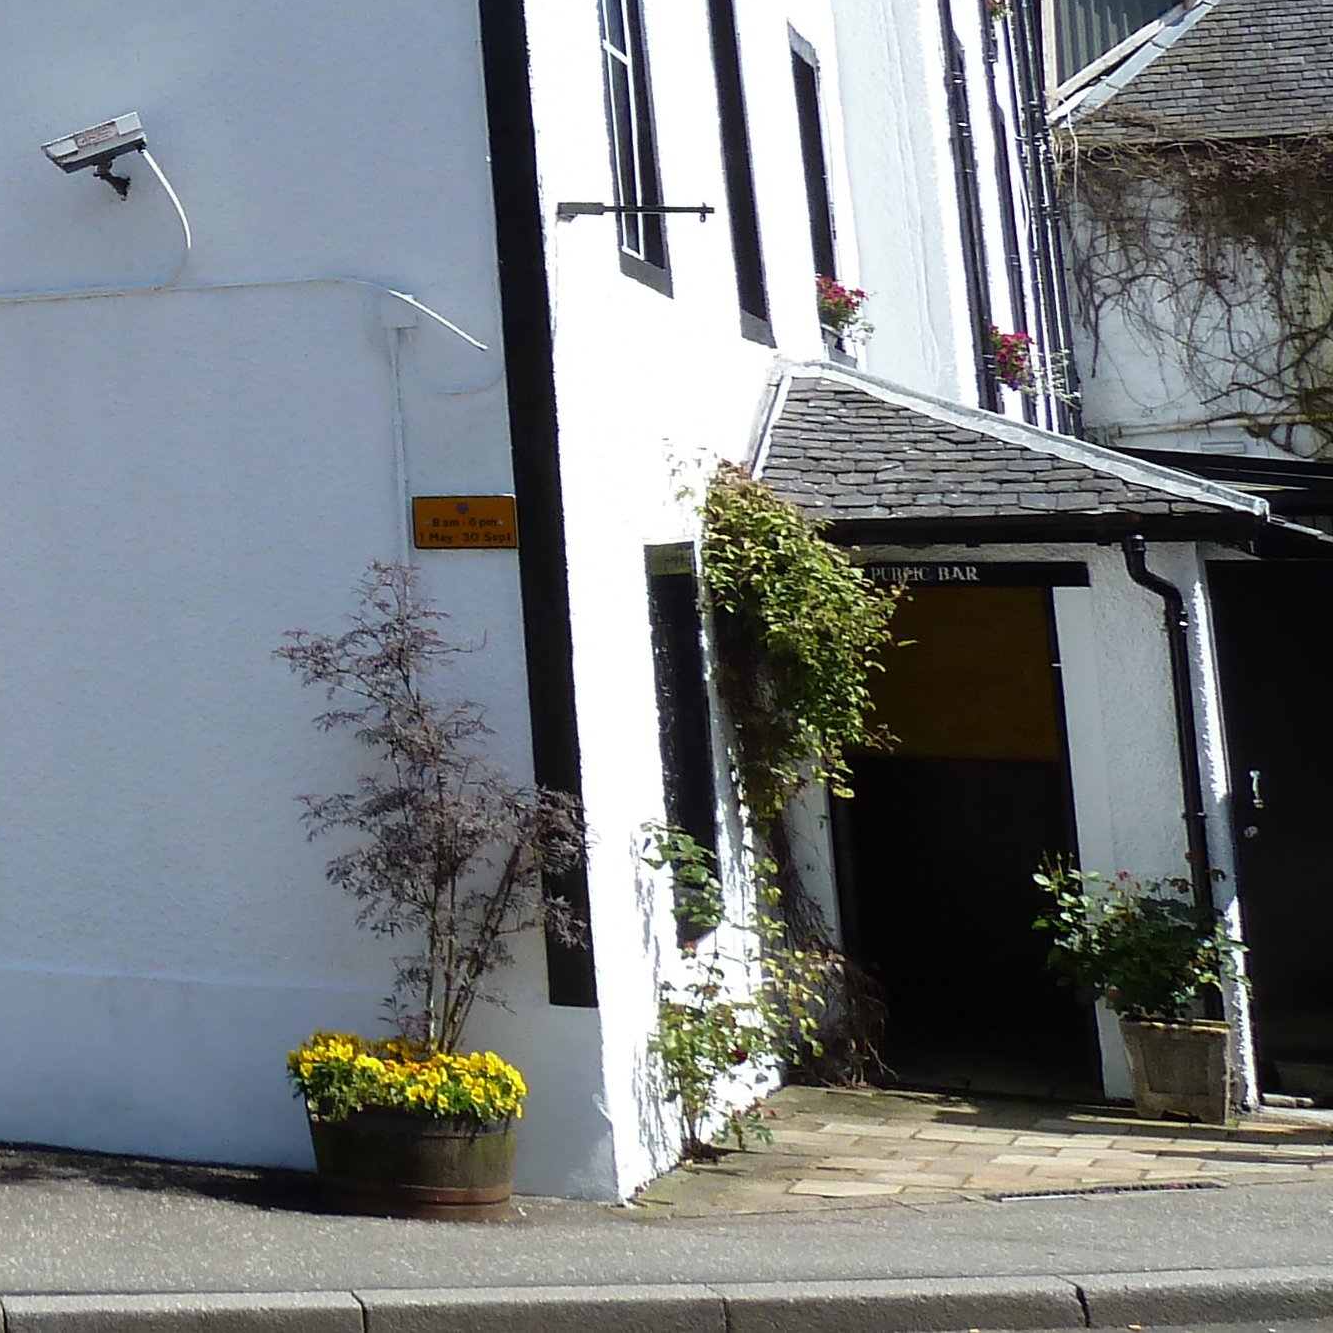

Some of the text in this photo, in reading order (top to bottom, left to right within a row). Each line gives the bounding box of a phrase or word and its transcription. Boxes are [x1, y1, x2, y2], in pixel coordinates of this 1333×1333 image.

[442, 519, 460, 527] am
[479, 519, 497, 529] pm
[429, 533, 453, 544] May
[462, 532, 479, 542] 30
[484, 532, 513, 543] Sept
[938, 566, 980, 581] BAR
